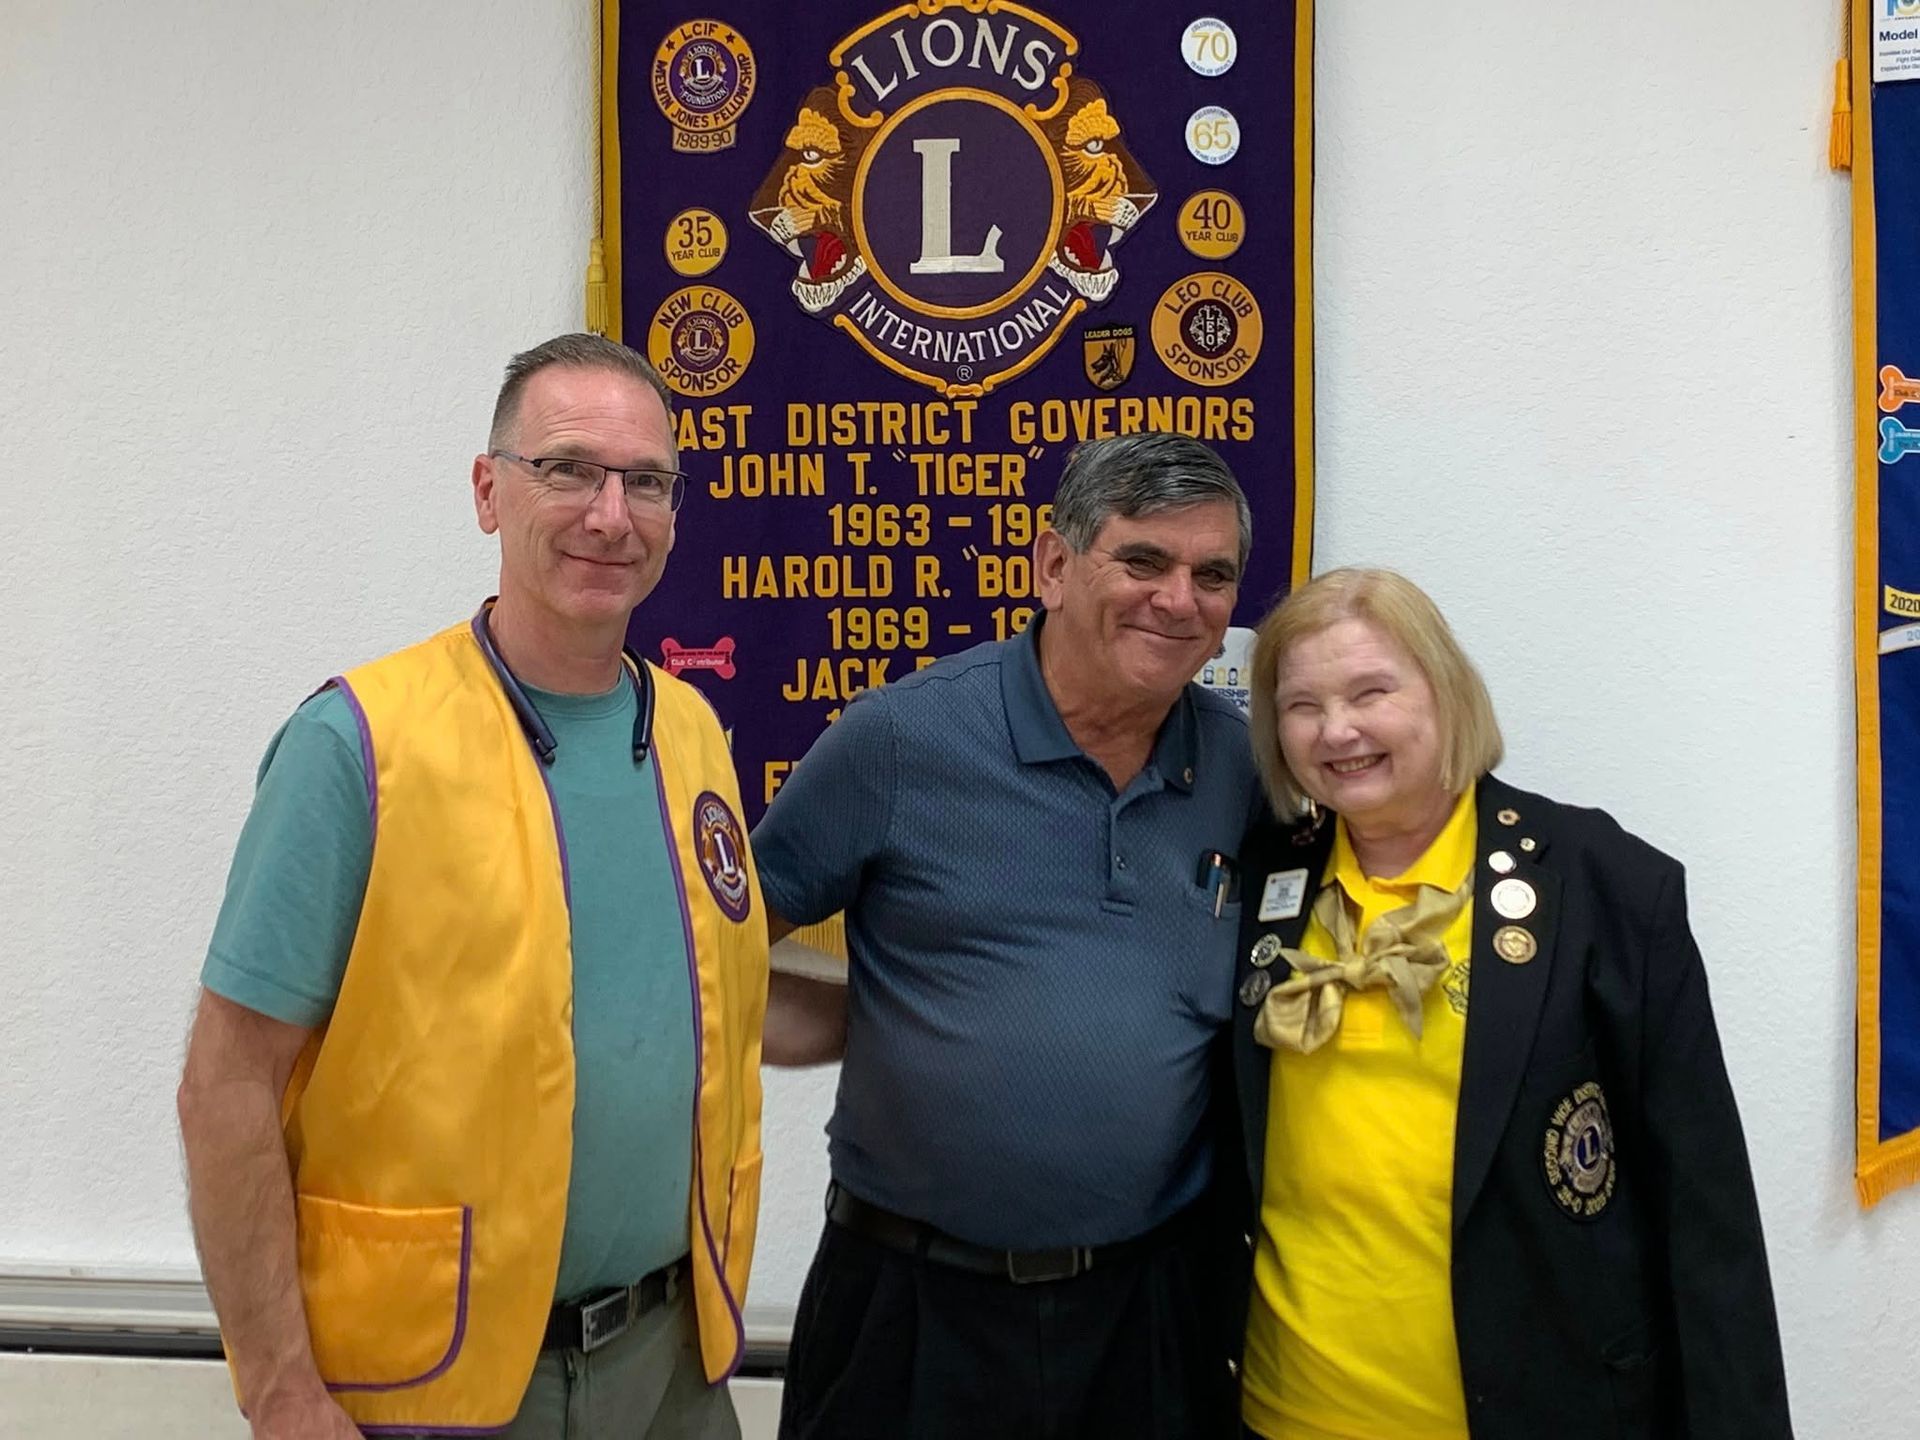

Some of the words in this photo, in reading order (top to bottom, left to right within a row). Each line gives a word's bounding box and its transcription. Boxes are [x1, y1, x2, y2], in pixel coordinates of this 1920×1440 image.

[680, 22, 719, 40] LCIF
[1191, 32, 1229, 61] 70
[1879, 28, 1918, 41] Model
[695, 58, 710, 79] L
[851, 19, 1056, 101] LIONS
[655, 60, 674, 110] MELVIN
[670, 108, 709, 128] JONES
[713, 53, 752, 126] FELLOWSHIP
[681, 88, 727, 106] FOUNDATION
[1193, 120, 1232, 150] 65
[910, 138, 1004, 274] L
[1193, 199, 1231, 229] 40
[678, 216, 712, 248] 35
[1185, 231, 1212, 241] YEAR
[1216, 232, 1238, 242] CLUB
[671, 250, 695, 261] YEAR
[698, 248, 721, 258] CLUB
[658, 293, 691, 329] NEW
[701, 292, 744, 329] CLUB
[1164, 281, 1200, 315] LEO
[1212, 280, 1254, 318] CLUB
[693, 330, 708, 350] L
[849, 285, 1072, 363] INTERNATIONAL
[1084, 330, 1111, 339] LEADER
[1112, 327, 1133, 336] DOGS
[1206, 308, 1215, 345] LEO
[659, 357, 742, 392] SPONSOR
[1165, 343, 1252, 380] SPONSOR
[671, 405, 752, 451] AST
[787, 401, 978, 446] DISTRICT
[1010, 397, 1254, 444] GOVERNORS
[709, 453, 825, 499] JOHN
[847, 453, 877, 496] T.
[828, 503, 931, 546] 1963
[723, 555, 893, 599] HAROLD
[915, 556, 951, 597] R.
[1890, 594, 1920, 613] 2020
[828, 607, 929, 650] 1969
[687, 658, 725, 666] Cntributor
[782, 657, 891, 702] JACK
[714, 833, 735, 874] L
[1551, 1098, 1574, 1126] VICE
